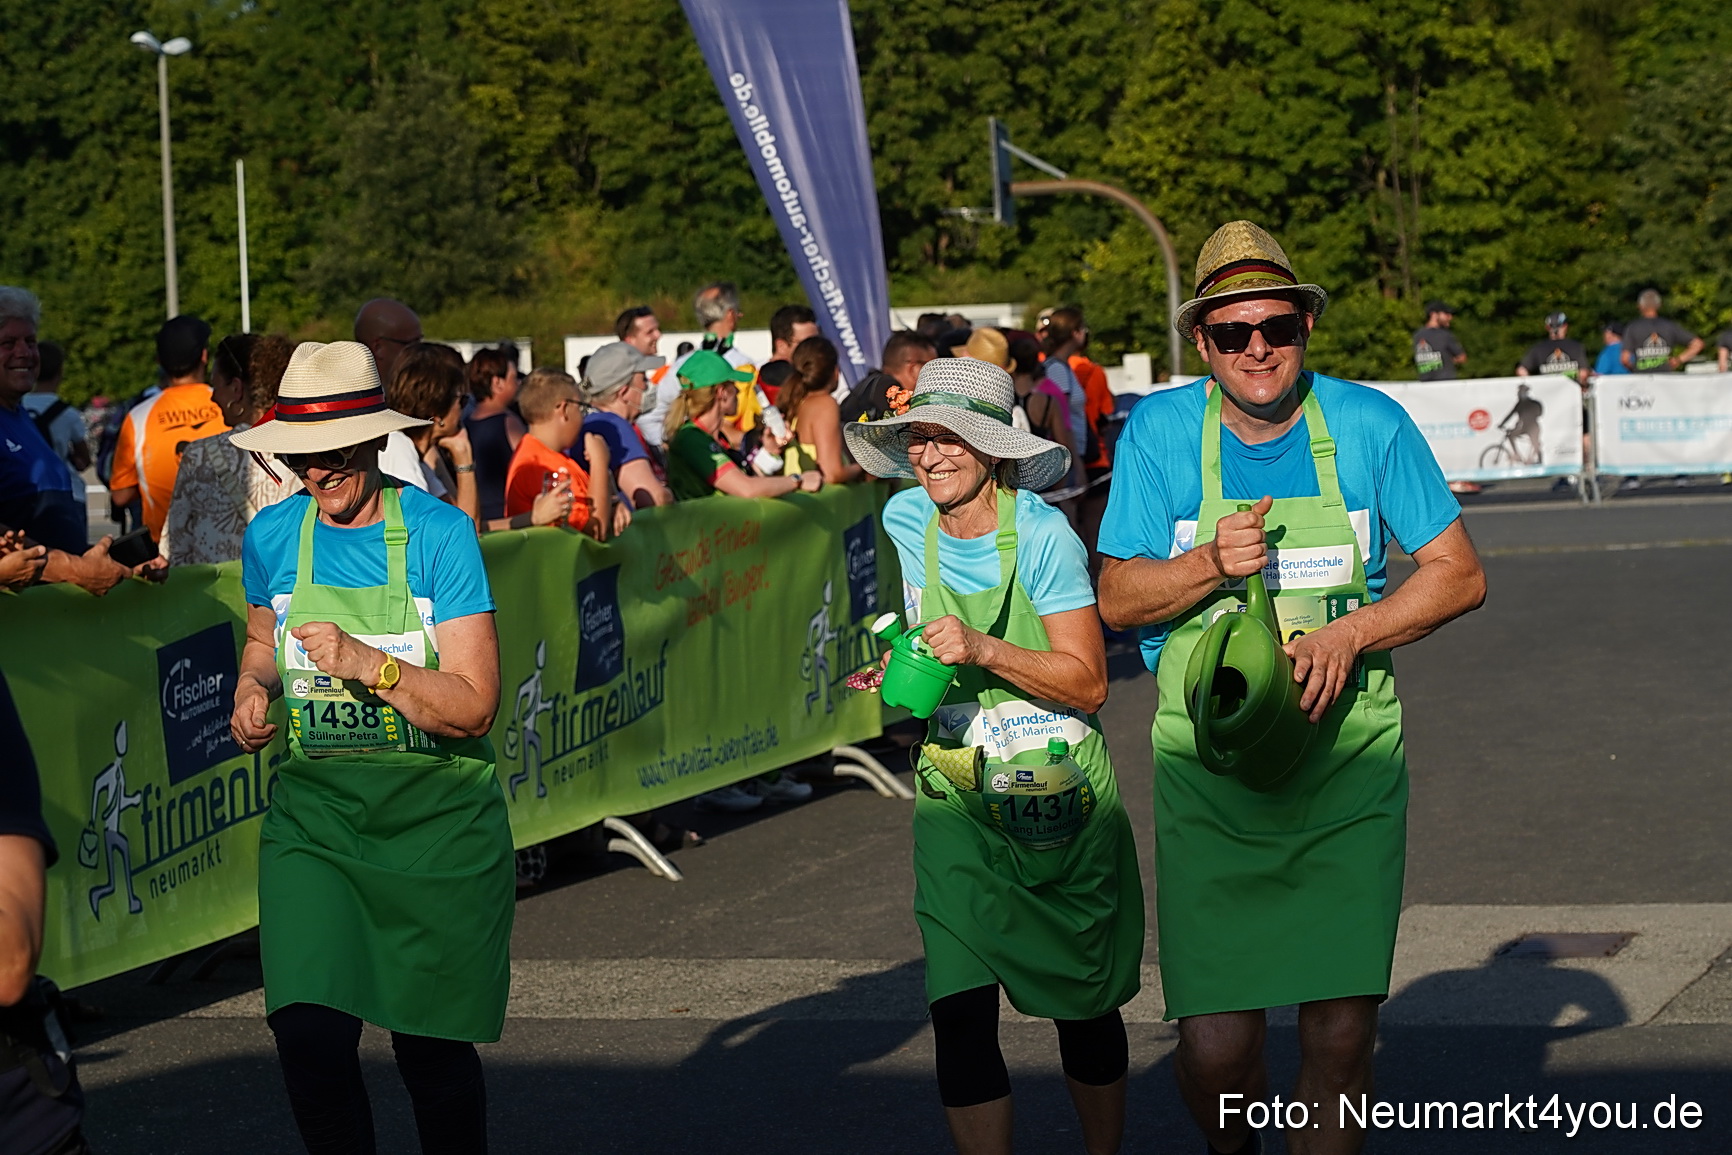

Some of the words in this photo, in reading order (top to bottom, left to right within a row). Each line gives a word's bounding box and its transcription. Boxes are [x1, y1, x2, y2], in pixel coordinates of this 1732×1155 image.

[165, 406, 219, 423] WINGS
[1281, 556, 1344, 570] Grundschule
[1288, 571, 1300, 579] St.
[1300, 569, 1330, 579] Marien
[378, 642, 414, 654] dschule
[173, 673, 223, 710] Fischer
[180, 696, 221, 722] AUTOMOBILE
[302, 700, 381, 729] 1438
[1000, 707, 1079, 732] Grundschule
[308, 730, 347, 741] Süllner
[349, 731, 378, 741] Petra
[382, 706, 398, 742] 2022
[995, 735, 1009, 749] aus
[1008, 730, 1020, 742] St.
[1022, 726, 1064, 738] Marien
[553, 741, 609, 787] neumarkt
[1010, 781, 1048, 789] Firmenlauf
[1003, 786, 1078, 823] 1437
[1007, 823, 1033, 837] Lang
[150, 839, 223, 900] neumarkt
